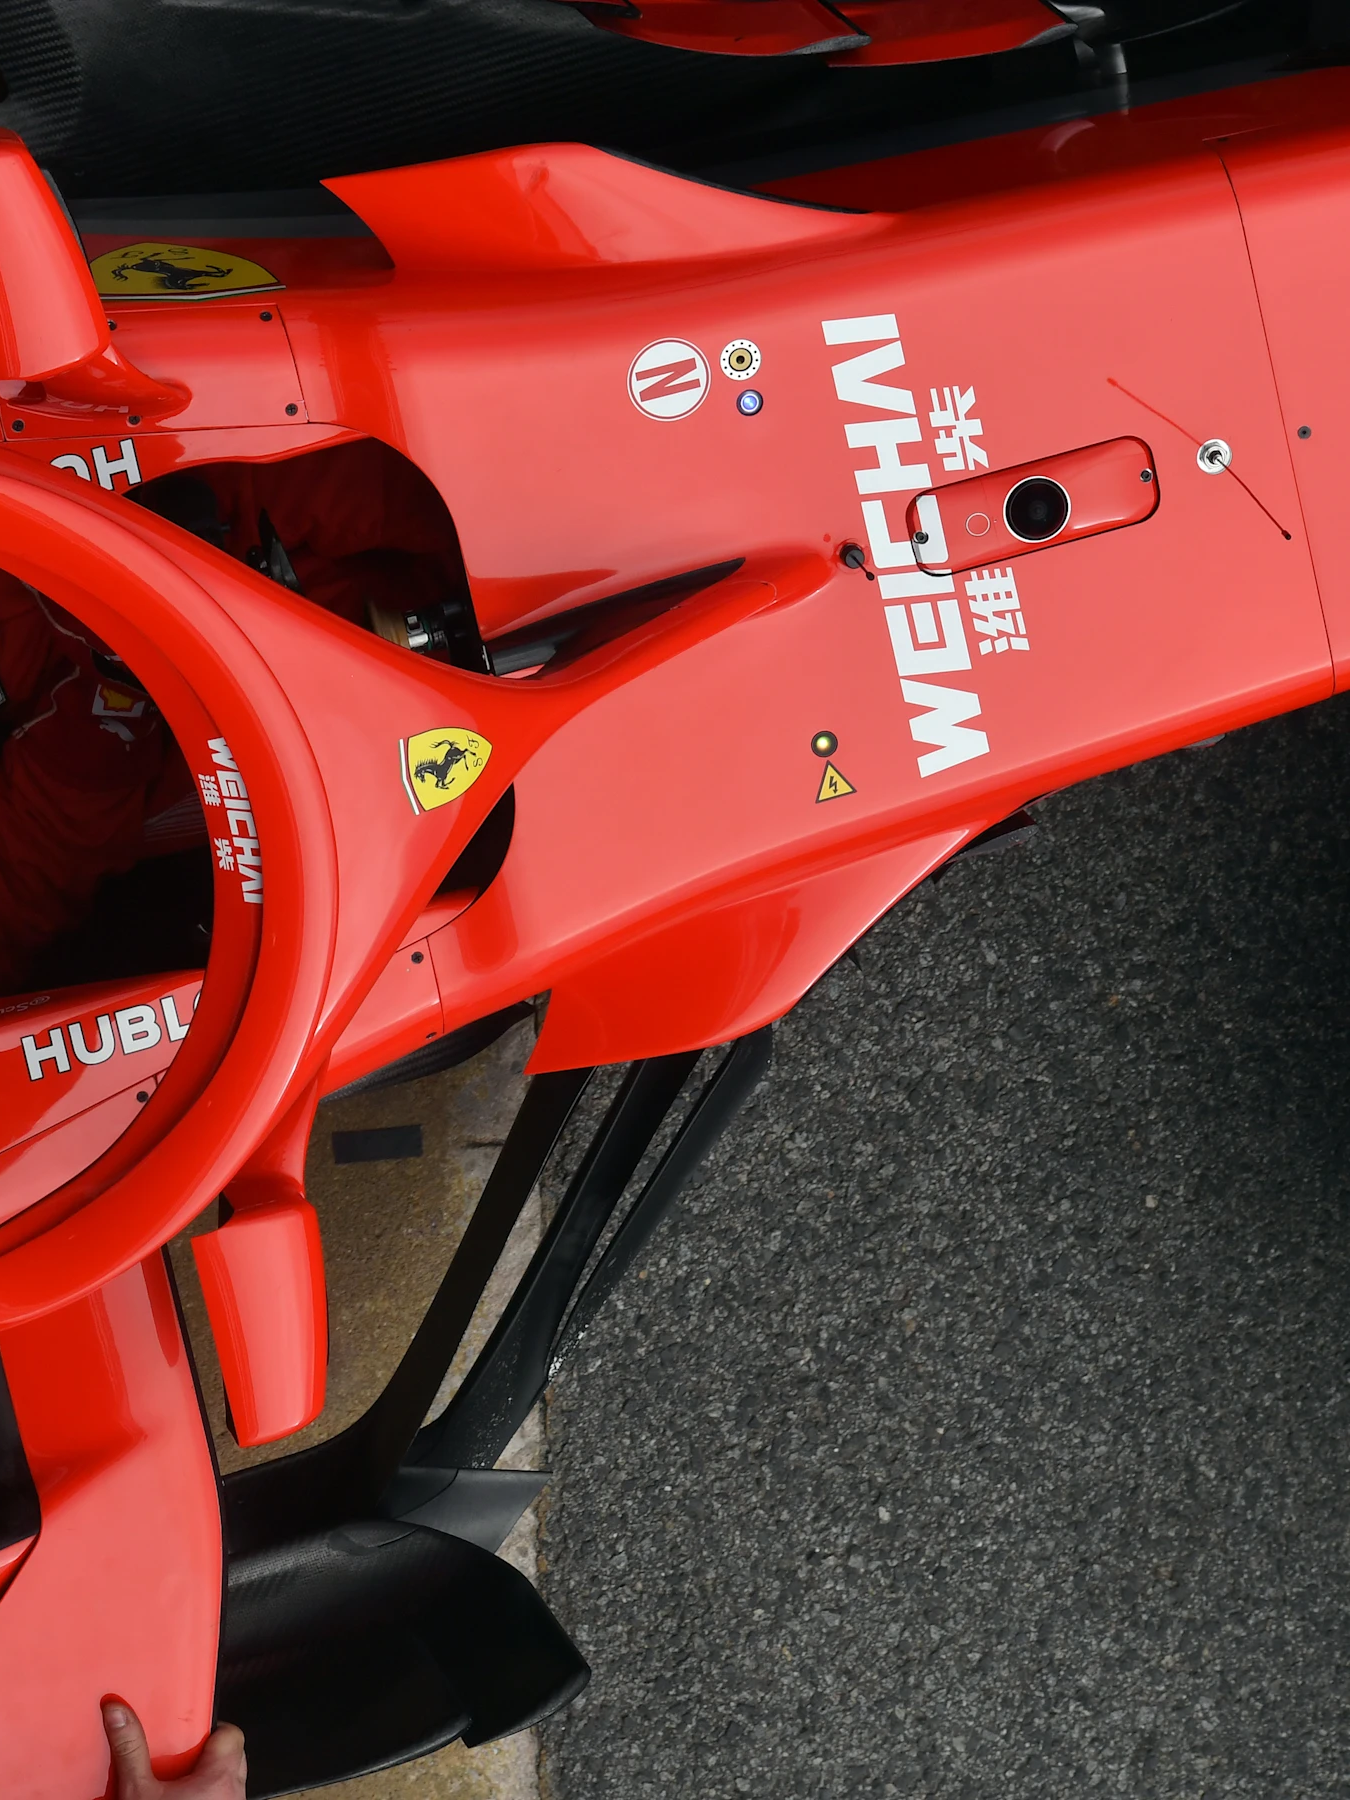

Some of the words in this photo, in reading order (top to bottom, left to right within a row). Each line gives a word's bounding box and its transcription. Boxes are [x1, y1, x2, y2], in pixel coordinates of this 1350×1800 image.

[820, 312, 991, 779] WEICHAI
[207, 736, 263, 905] WEICHAI
[21, 989, 204, 1082] HUBL
